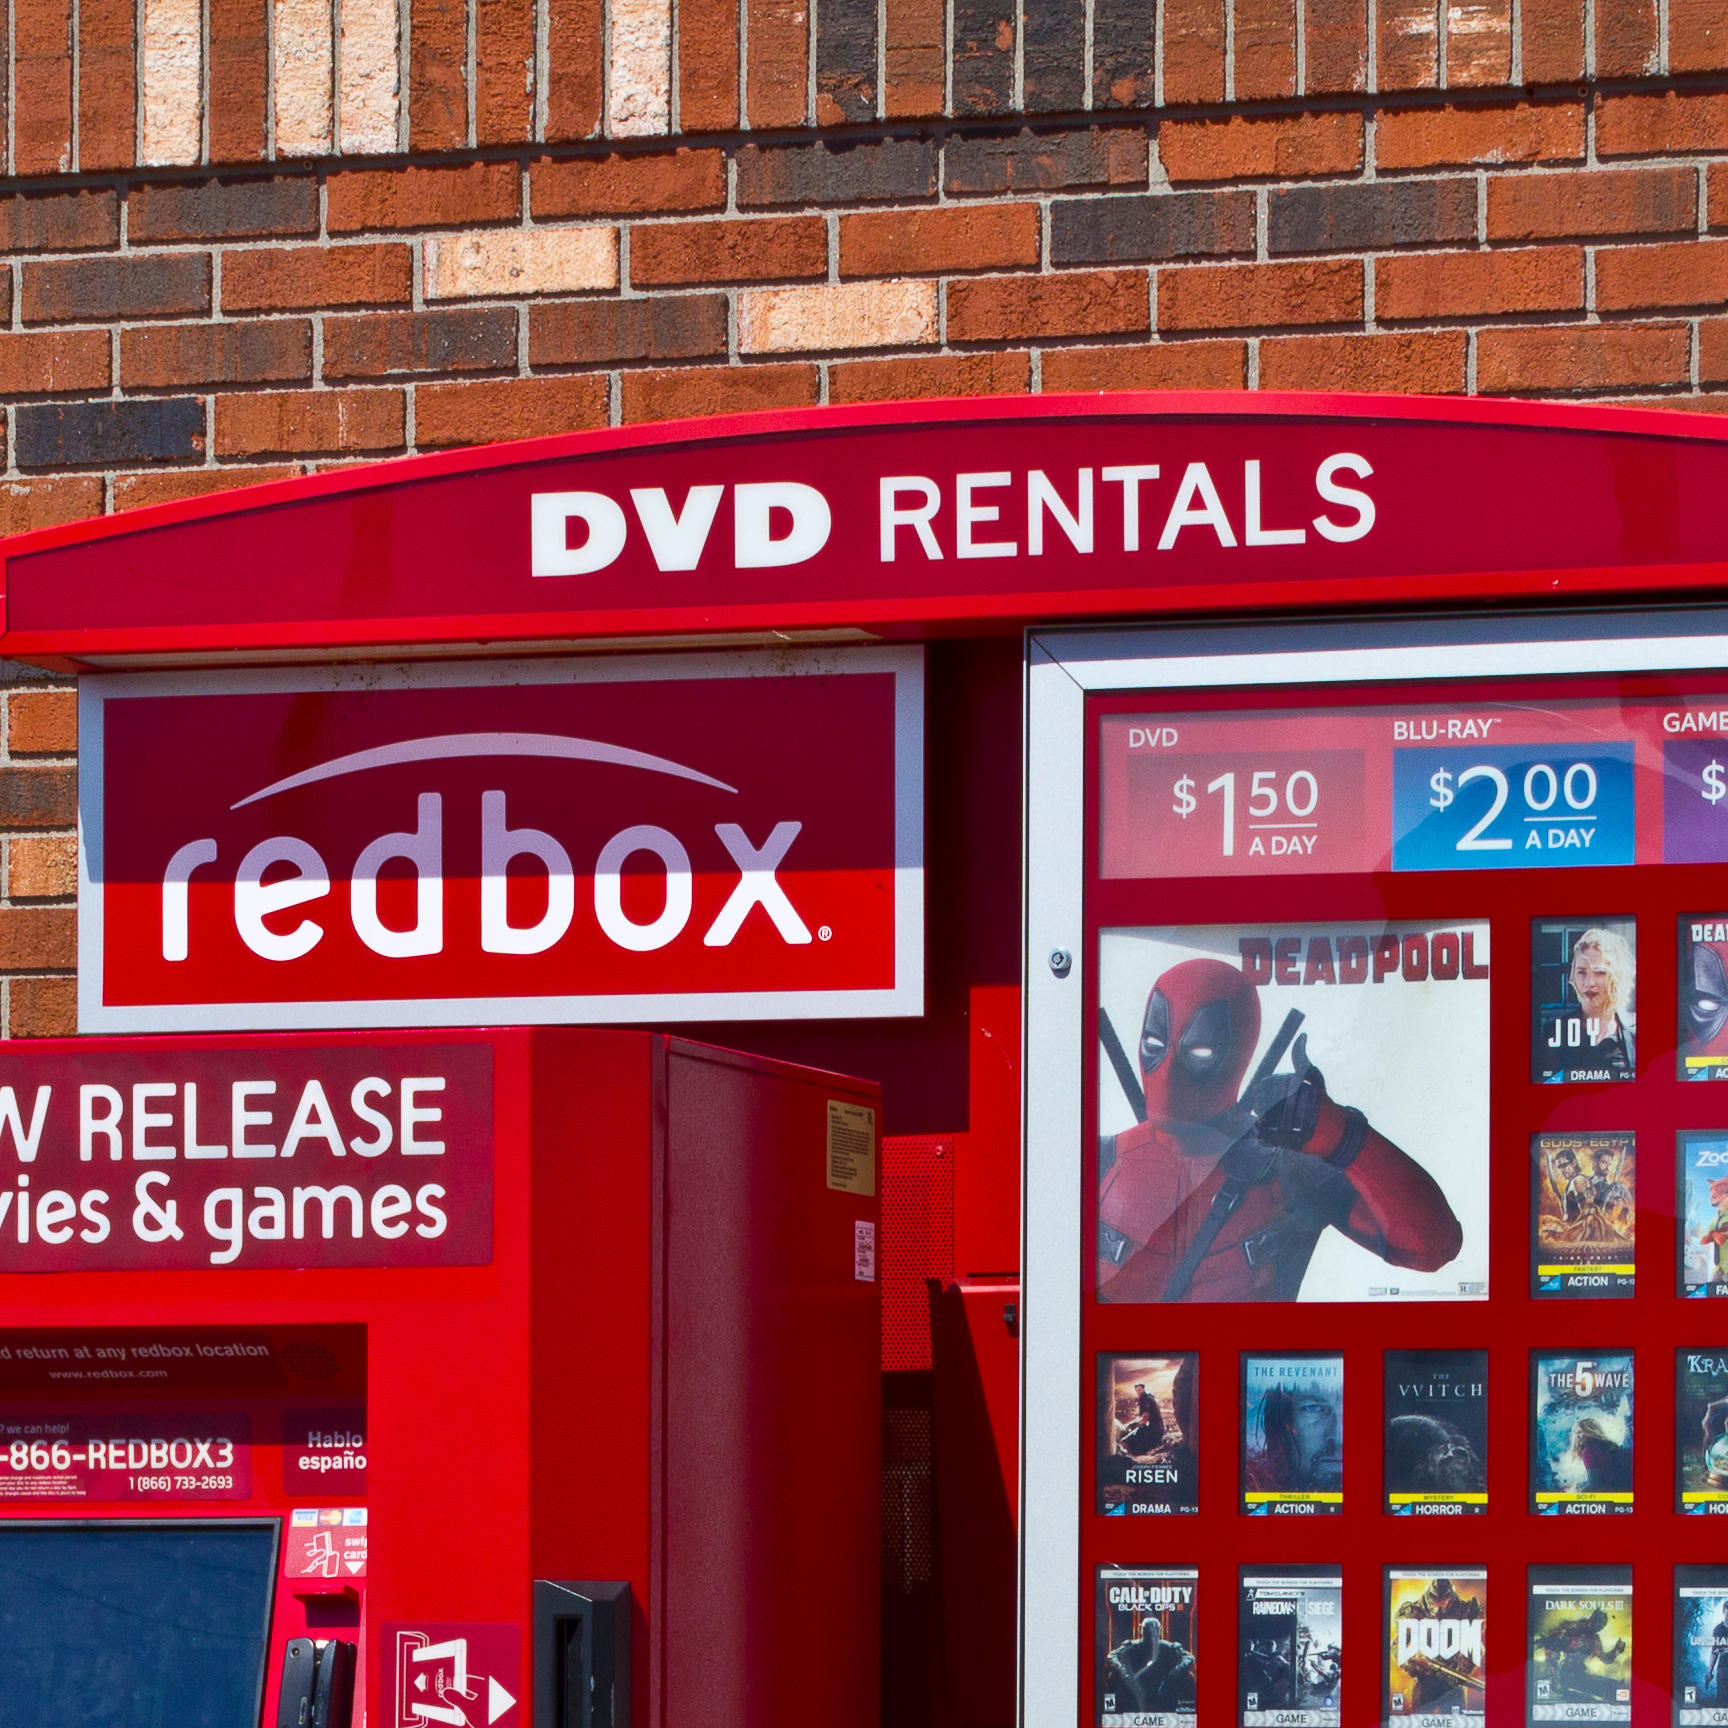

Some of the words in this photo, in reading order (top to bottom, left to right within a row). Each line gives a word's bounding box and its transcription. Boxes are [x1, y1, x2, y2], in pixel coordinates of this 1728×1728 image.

[530, 481, 832, 578] DVD
[879, 452, 1376, 563] RENTALS
[1128, 728, 1178, 747] DVD
[1249, 836, 1264, 855] A
[1270, 835, 1317, 855] DAY
[1526, 830, 1542, 849] A
[1548, 829, 1595, 849] DAY
[161, 786, 812, 964] redbox
[1239, 931, 1488, 986] DEADPOOL
[1548, 1018, 1601, 1047] JOY
[1571, 1070, 1610, 1081] DRAMA
[80, 1077, 446, 1163] RELEASE
[132, 1170, 184, 1241] &
[204, 1178, 448, 1266] games
[1568, 1276, 1608, 1287] ACTION
[16, 1345, 69, 1360] return
[75, 1346, 93, 1358] at
[97, 1346, 126, 1361] any
[131, 1343, 193, 1358] redbox
[197, 1343, 269, 1357] location
[50, 1368, 167, 1379] www.redbox.com
[1254, 1367, 1275, 1376] THE
[1279, 1367, 1338, 1377] REVENANT
[1550, 1373, 1573, 1388] THE
[1595, 1374, 1628, 1388] WAVE
[7, 1425, 19, 1434] we
[22, 1425, 39, 1434] can
[43, 1422, 69, 1436] help!
[308, 1432, 362, 1447] Hablo
[137, 1476, 172, 1491] (866)
[175, 1475, 233, 1490] 733-2693
[1126, 1470, 1177, 1483] RISEN
[1132, 1504, 1171, 1514] DRAMA
[1566, 1503, 1606, 1514] ACTION
[1109, 1588, 1143, 1604] CALL
[1150, 1587, 1192, 1603] DUTY
[1546, 1601, 1575, 1610] DARK
[1579, 1601, 1614, 1610] SOULS
[1396, 1619, 1483, 1667] DOOM
[1134, 1716, 1164, 1727] GAME
